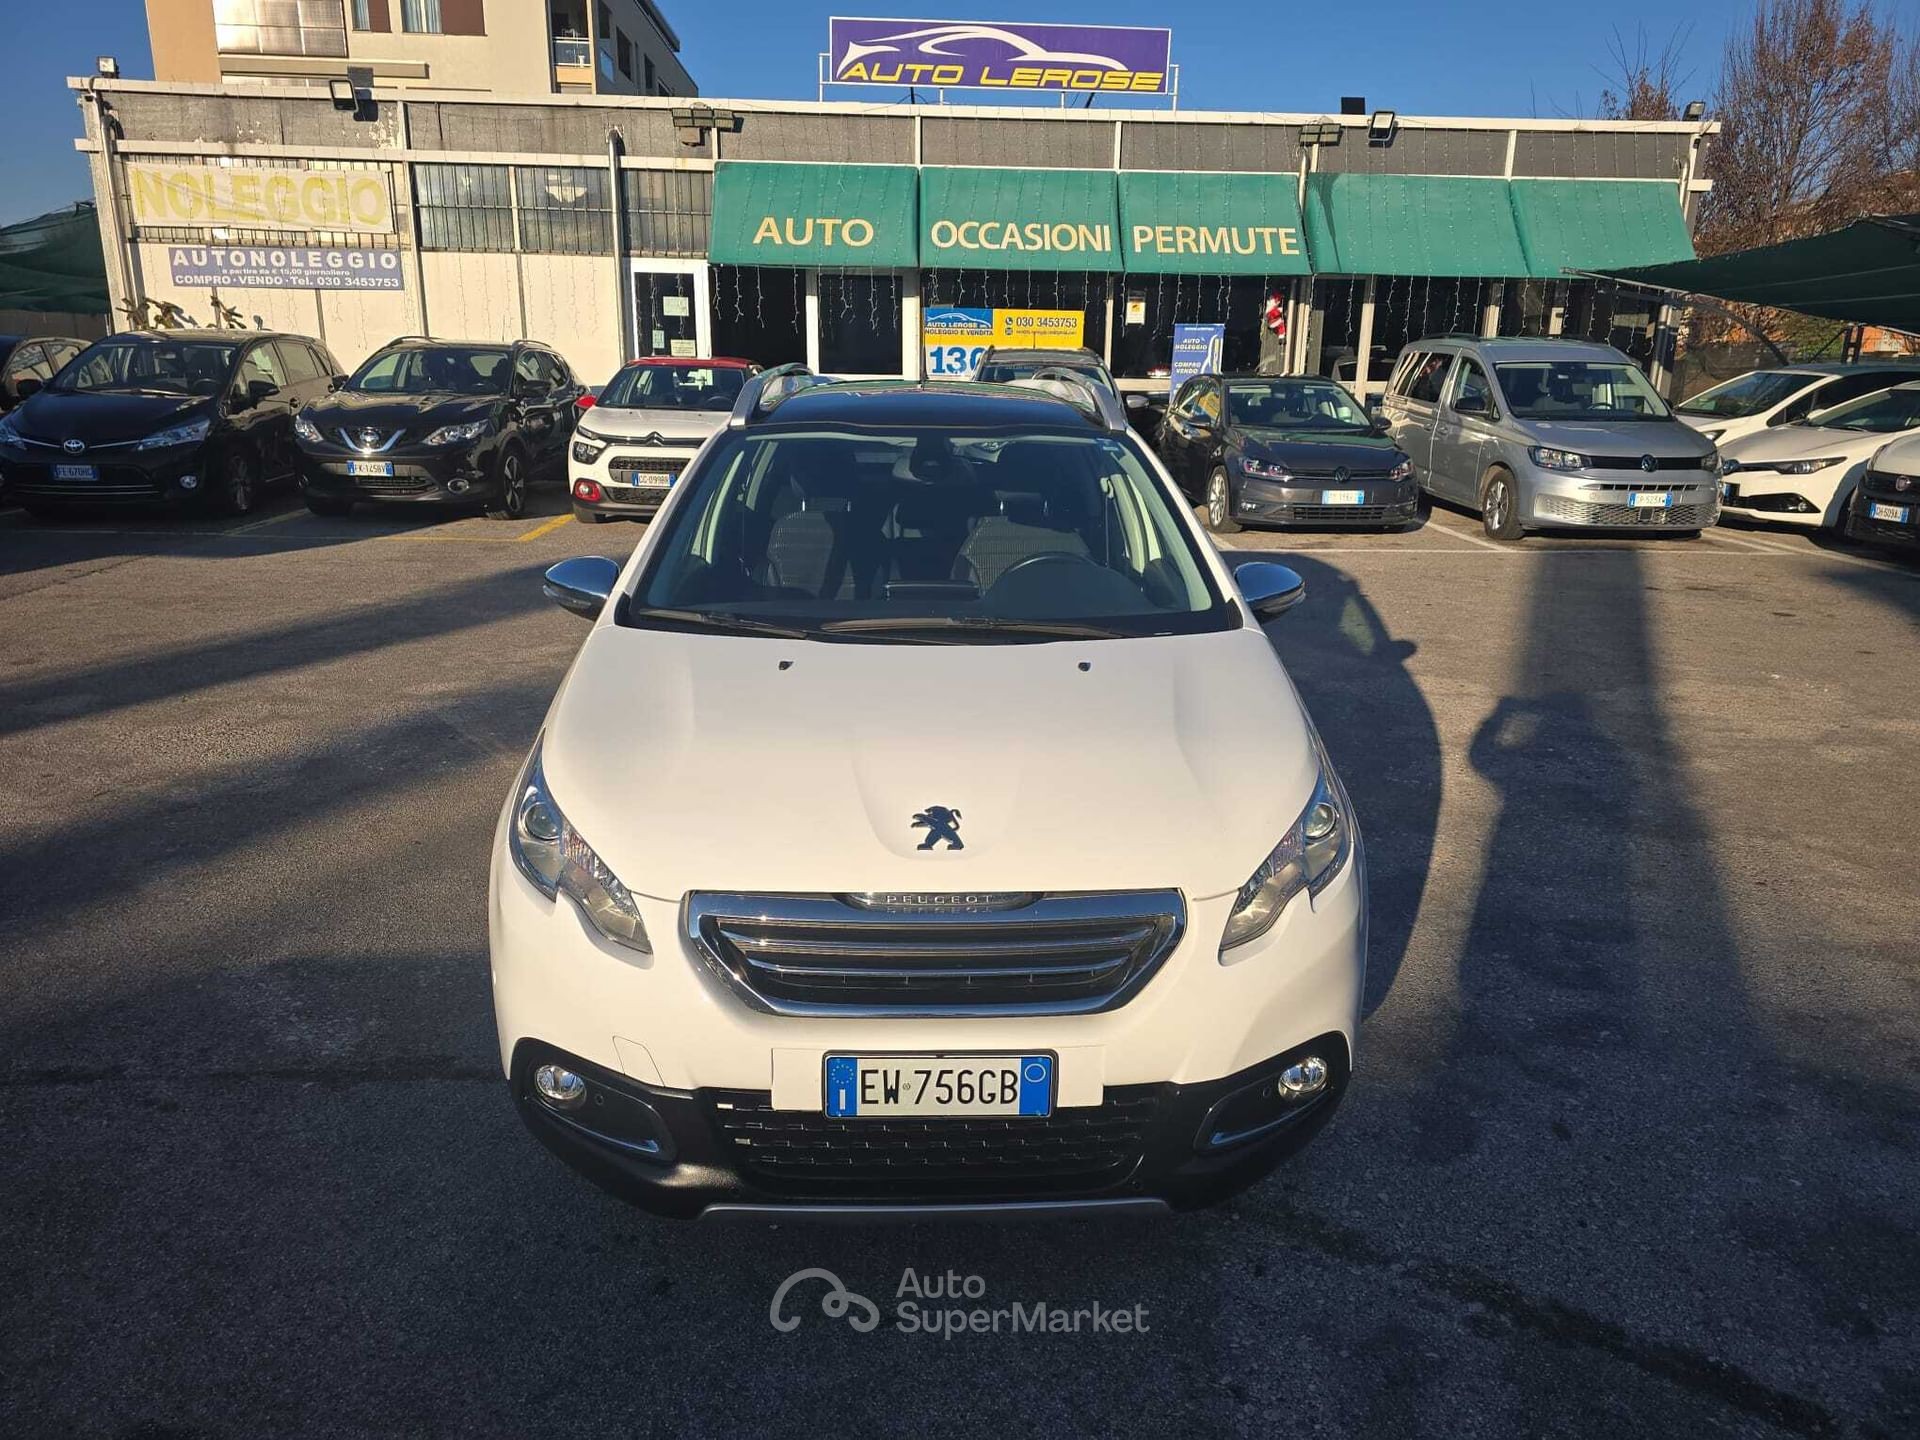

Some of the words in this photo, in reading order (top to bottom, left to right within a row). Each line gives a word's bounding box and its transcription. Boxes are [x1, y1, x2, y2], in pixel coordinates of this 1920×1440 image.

[840, 62, 965, 84] AUTO
[979, 66, 1164, 91] LEROSE
[132, 169, 386, 225] NOLEGGIO
[752, 217, 874, 247] AUTO
[931, 220, 1112, 252] OCCASIONI
[1132, 225, 1300, 255] PERMUTE
[173, 250, 398, 269] AUTONOLEGGIO
[175, 275, 231, 284] COMPRO
[239, 276, 283, 285] VENDO
[290, 276, 313, 285] Tel.
[317, 277, 340, 286] 030
[345, 277, 399, 287] 3453753
[1016, 316, 1034, 327] 030
[1036, 317, 1078, 328] 3453753
[886, 895, 993, 904] PEUGEOT
